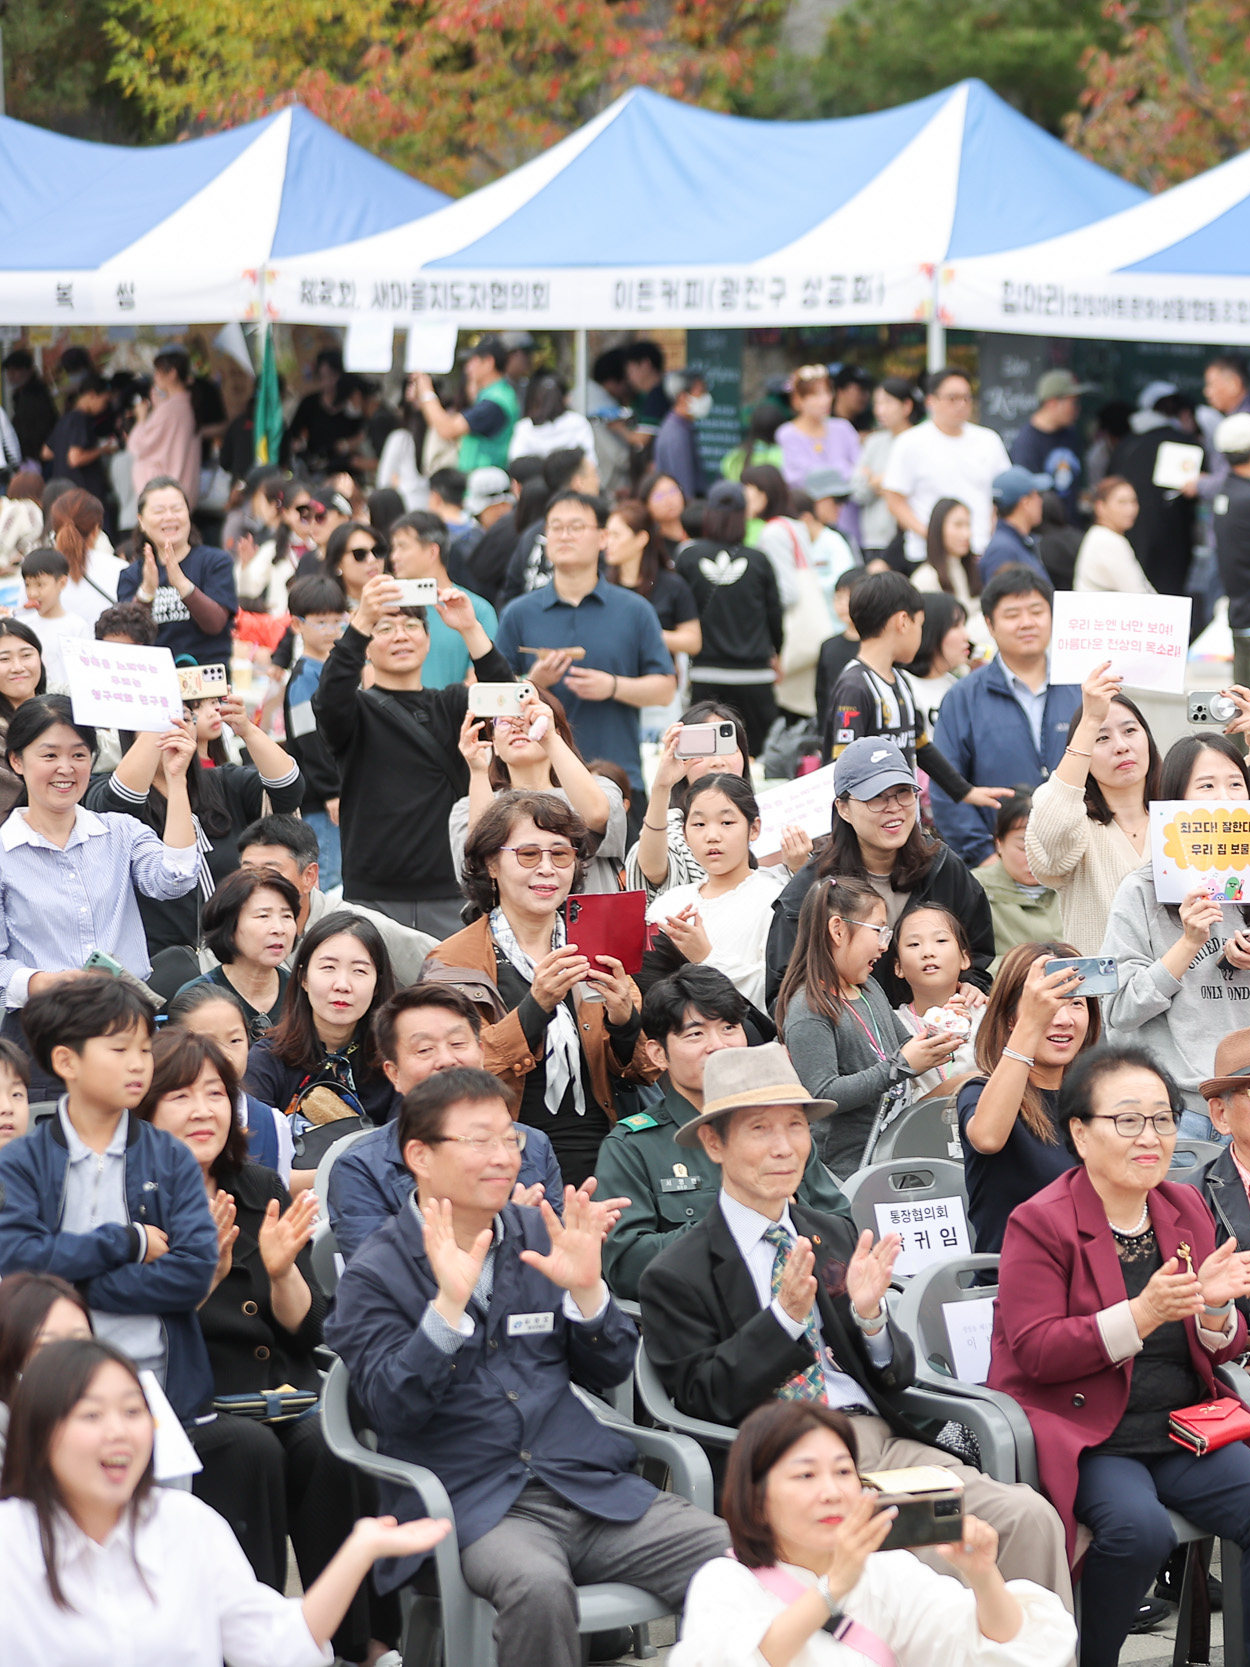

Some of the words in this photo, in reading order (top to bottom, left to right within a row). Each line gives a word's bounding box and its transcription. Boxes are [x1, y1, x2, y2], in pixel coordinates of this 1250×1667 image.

[371, 280, 549, 313] 새마을지도자협의회
[1068, 619, 1090, 631] 우리
[1094, 619, 1117, 631] 눈엔
[1121, 620, 1144, 632] 너만
[1147, 622, 1174, 636] 보여!
[1058, 638, 1103, 650] 아름다운
[1107, 638, 1142, 652] 천상의
[1146, 641, 1181, 657] 목소리!
[1180, 821, 1218, 833] 최고다!
[1191, 844, 1213, 855] 우리
[1217, 843, 1227, 855] 집
[1231, 843, 1250, 855] 보물
[1201, 985, 1223, 999] ONLY
[890, 1205, 948, 1224] 통장협의회
